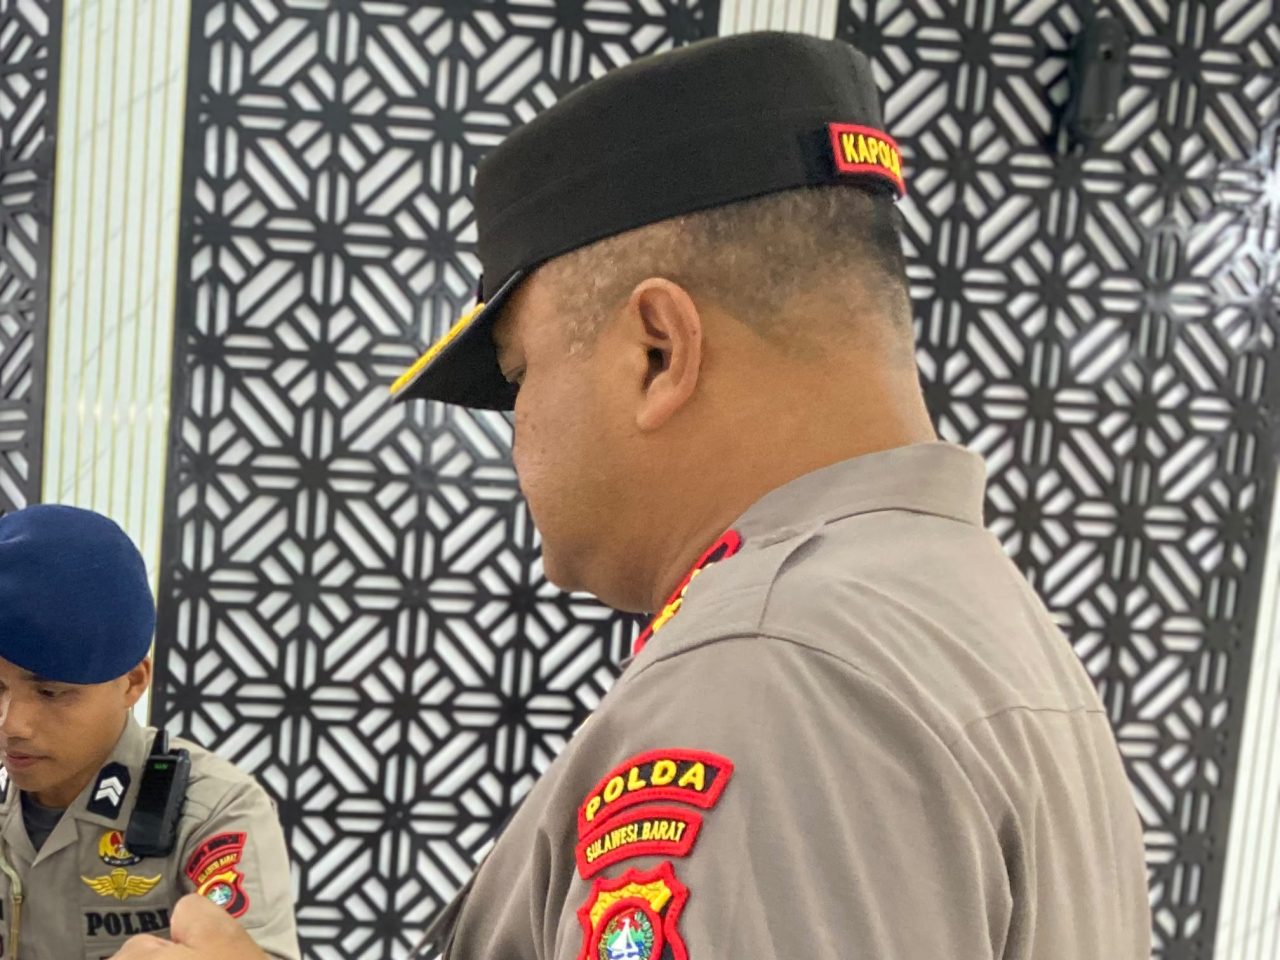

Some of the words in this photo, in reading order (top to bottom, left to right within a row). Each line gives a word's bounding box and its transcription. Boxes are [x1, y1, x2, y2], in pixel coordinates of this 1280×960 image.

[842, 133, 902, 179] KAPOL
[586, 759, 705, 821] POLDA
[586, 823, 639, 863] SULAWESI
[642, 820, 686, 843] BARAT
[84, 909, 170, 936] POLRI
